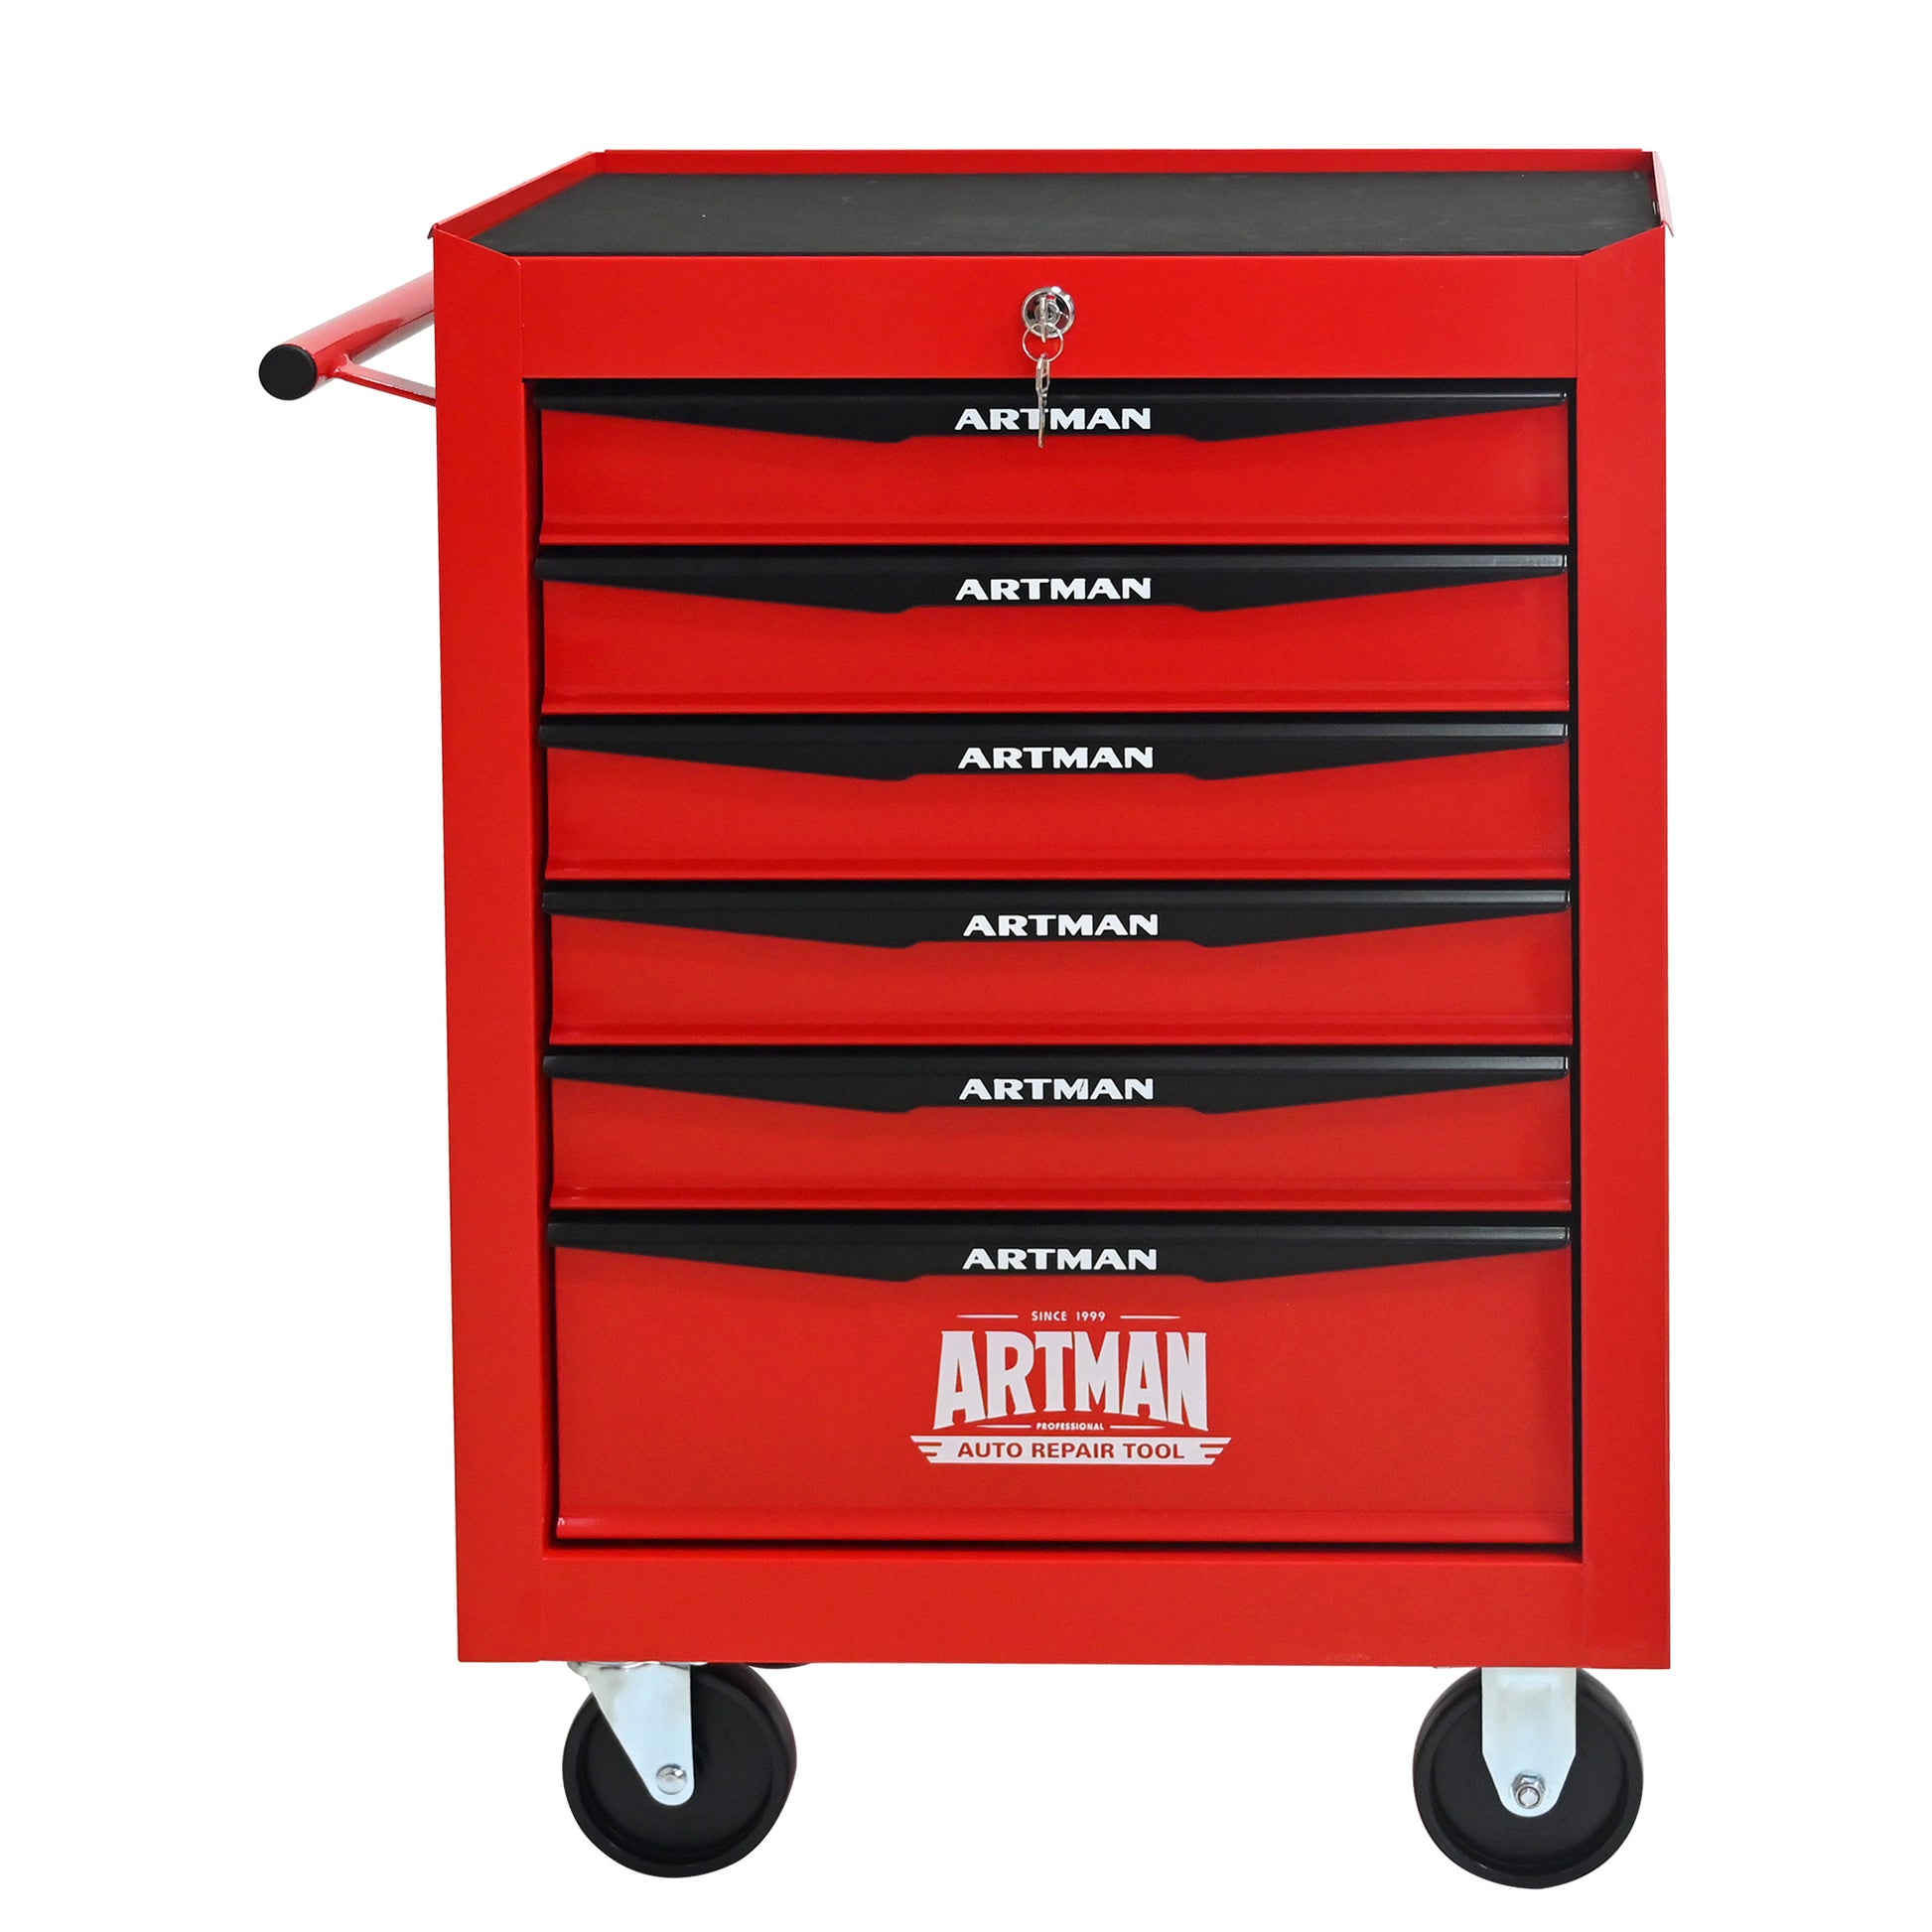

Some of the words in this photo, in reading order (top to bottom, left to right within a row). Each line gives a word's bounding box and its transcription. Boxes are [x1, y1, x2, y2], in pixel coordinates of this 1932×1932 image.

[954, 407, 1152, 430] ARTMAN
[954, 577, 1152, 601] ARTMAN
[957, 747, 1154, 769] ARTMAN
[962, 913, 1159, 937] ARTMAN
[958, 1077, 1154, 1100] ARTMAN
[962, 1248, 1158, 1271] ARTMAN
[1031, 1311, 1068, 1321] SINCE
[1075, 1311, 1106, 1321] 1999
[932, 1330, 1209, 1432] ARTMAN
[1035, 1422, 1105, 1431] PROFESSIONAL
[957, 1442, 1024, 1458] AUTO
[1031, 1442, 1115, 1459] REPAIR
[1122, 1443, 1185, 1459] TOOL
